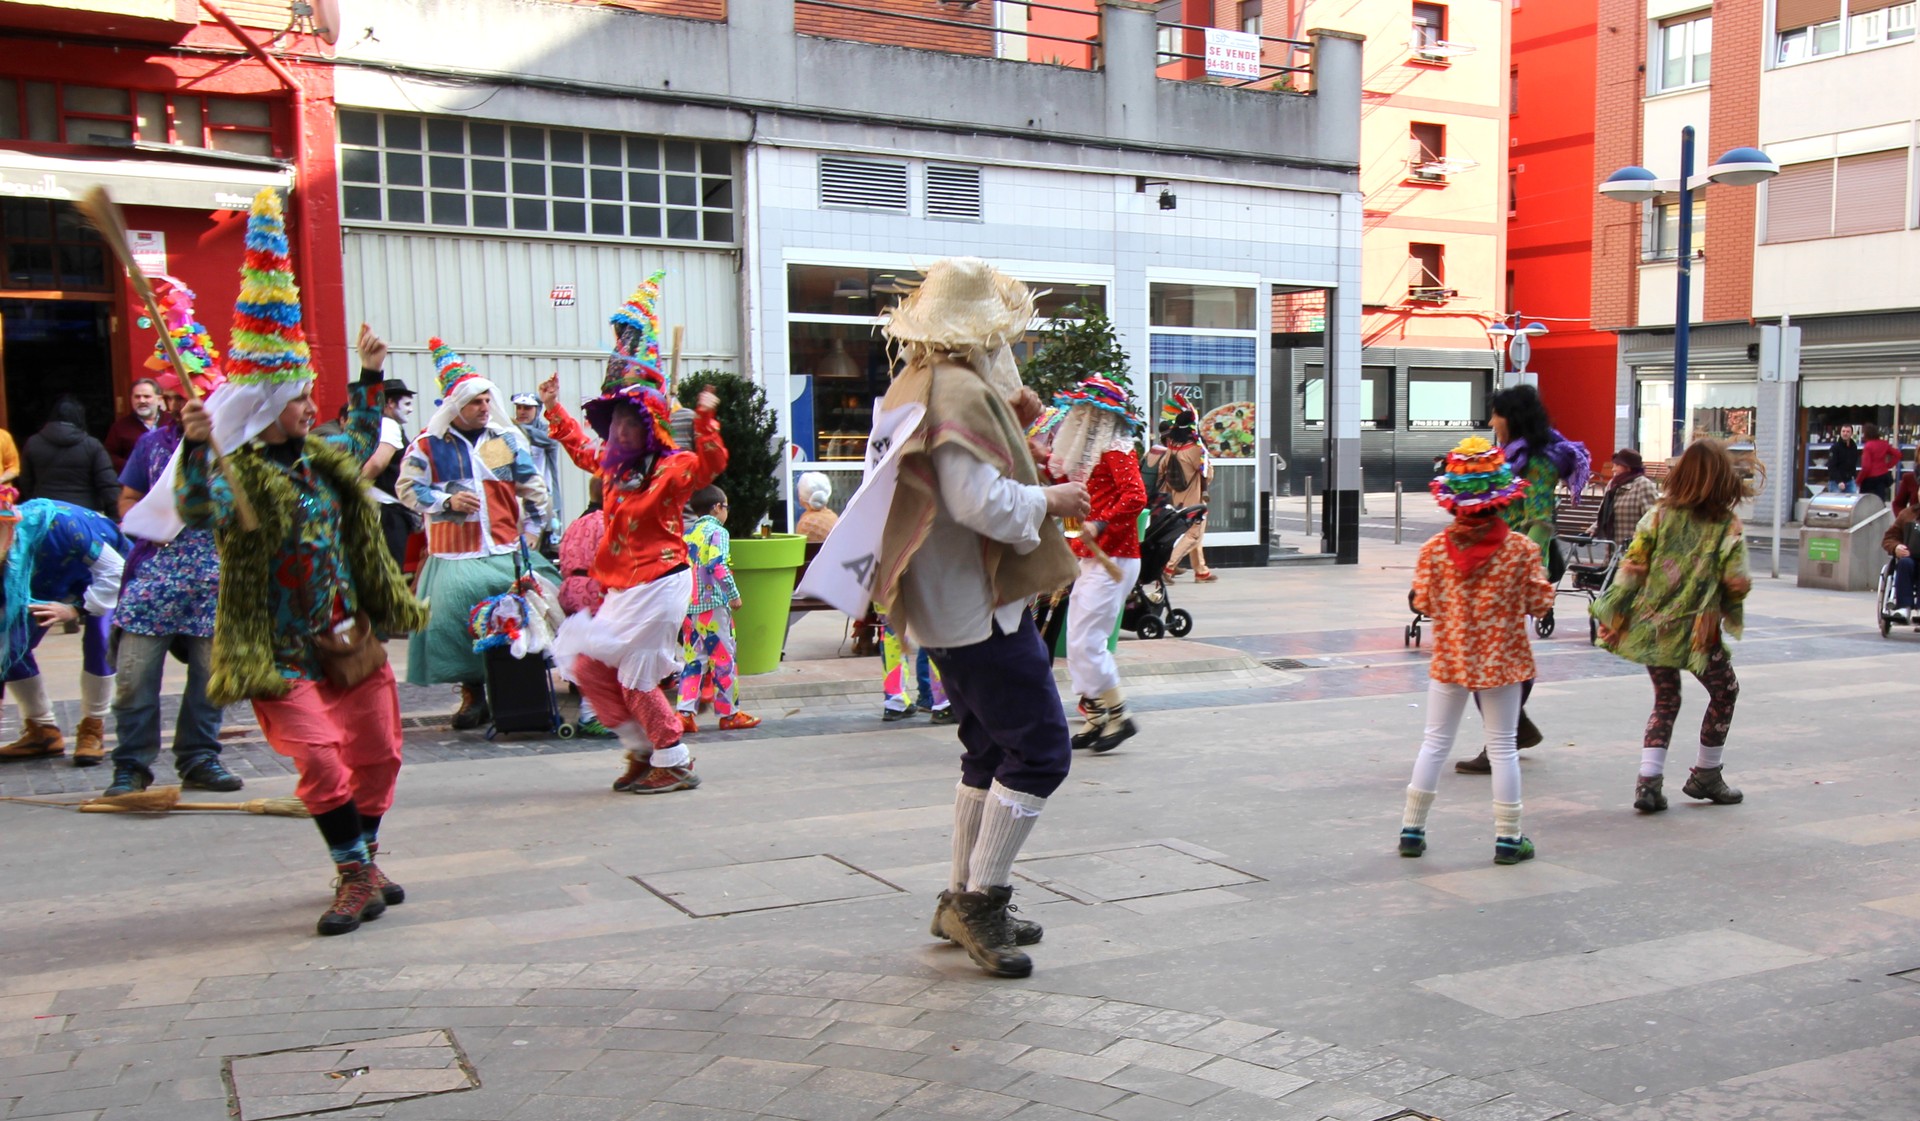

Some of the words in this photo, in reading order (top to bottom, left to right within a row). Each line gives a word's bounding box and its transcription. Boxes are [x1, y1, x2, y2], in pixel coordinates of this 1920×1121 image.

[1209, 46, 1221, 56] SE
[1226, 48, 1256, 61] VENDE
[1153, 379, 1203, 402] Pizza
